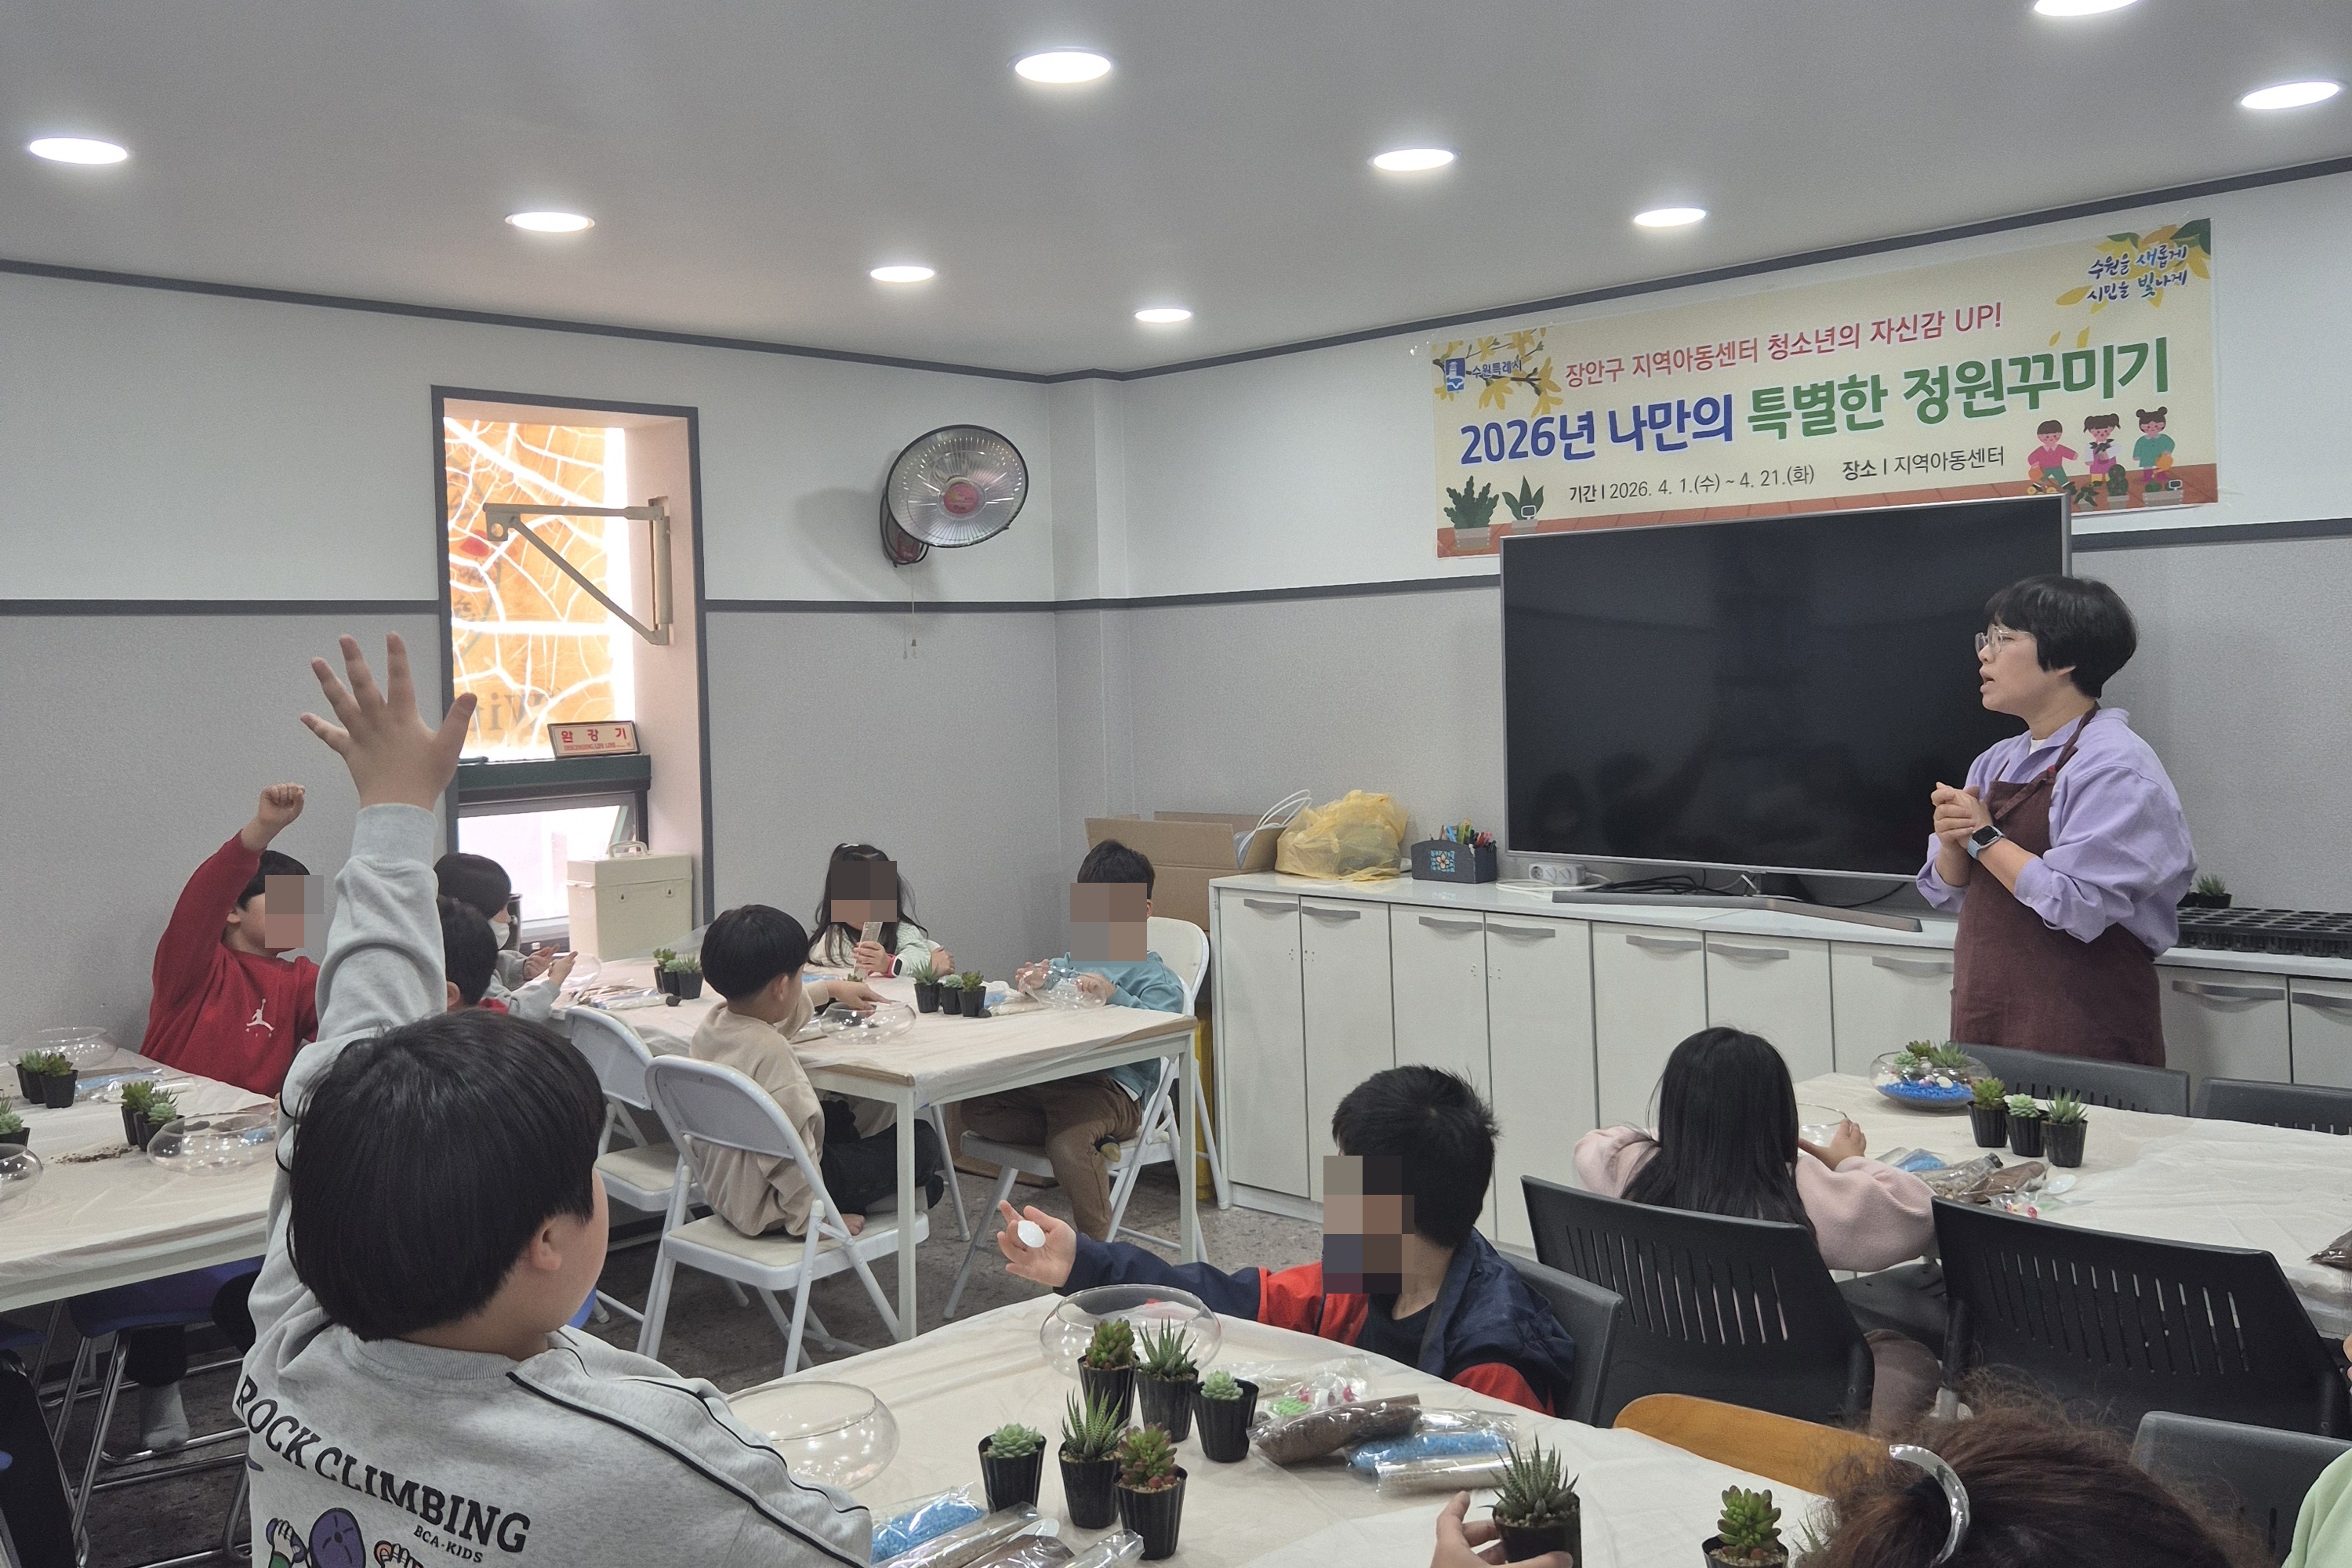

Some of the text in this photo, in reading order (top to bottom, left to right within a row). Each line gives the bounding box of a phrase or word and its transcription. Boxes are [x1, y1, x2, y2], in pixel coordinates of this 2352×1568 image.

[2088, 244, 2187, 279] 수원을 새롭게
[2087, 270, 2187, 302] 시민을 빛나게
[1566, 302, 2002, 388] 장안구 지역아동센터 청소년의 자신감 UP!
[1472, 359, 1522, 378] 수원특례시
[1461, 337, 2169, 464] 2026년 나만의 특별한 정원꾸미기
[1842, 459, 1878, 481] 장소
[1893, 445, 2005, 476] 지역아동센터
[1570, 485, 1596, 503] 기간
[236, 1374, 531, 1553] ROCK CLIMBING
